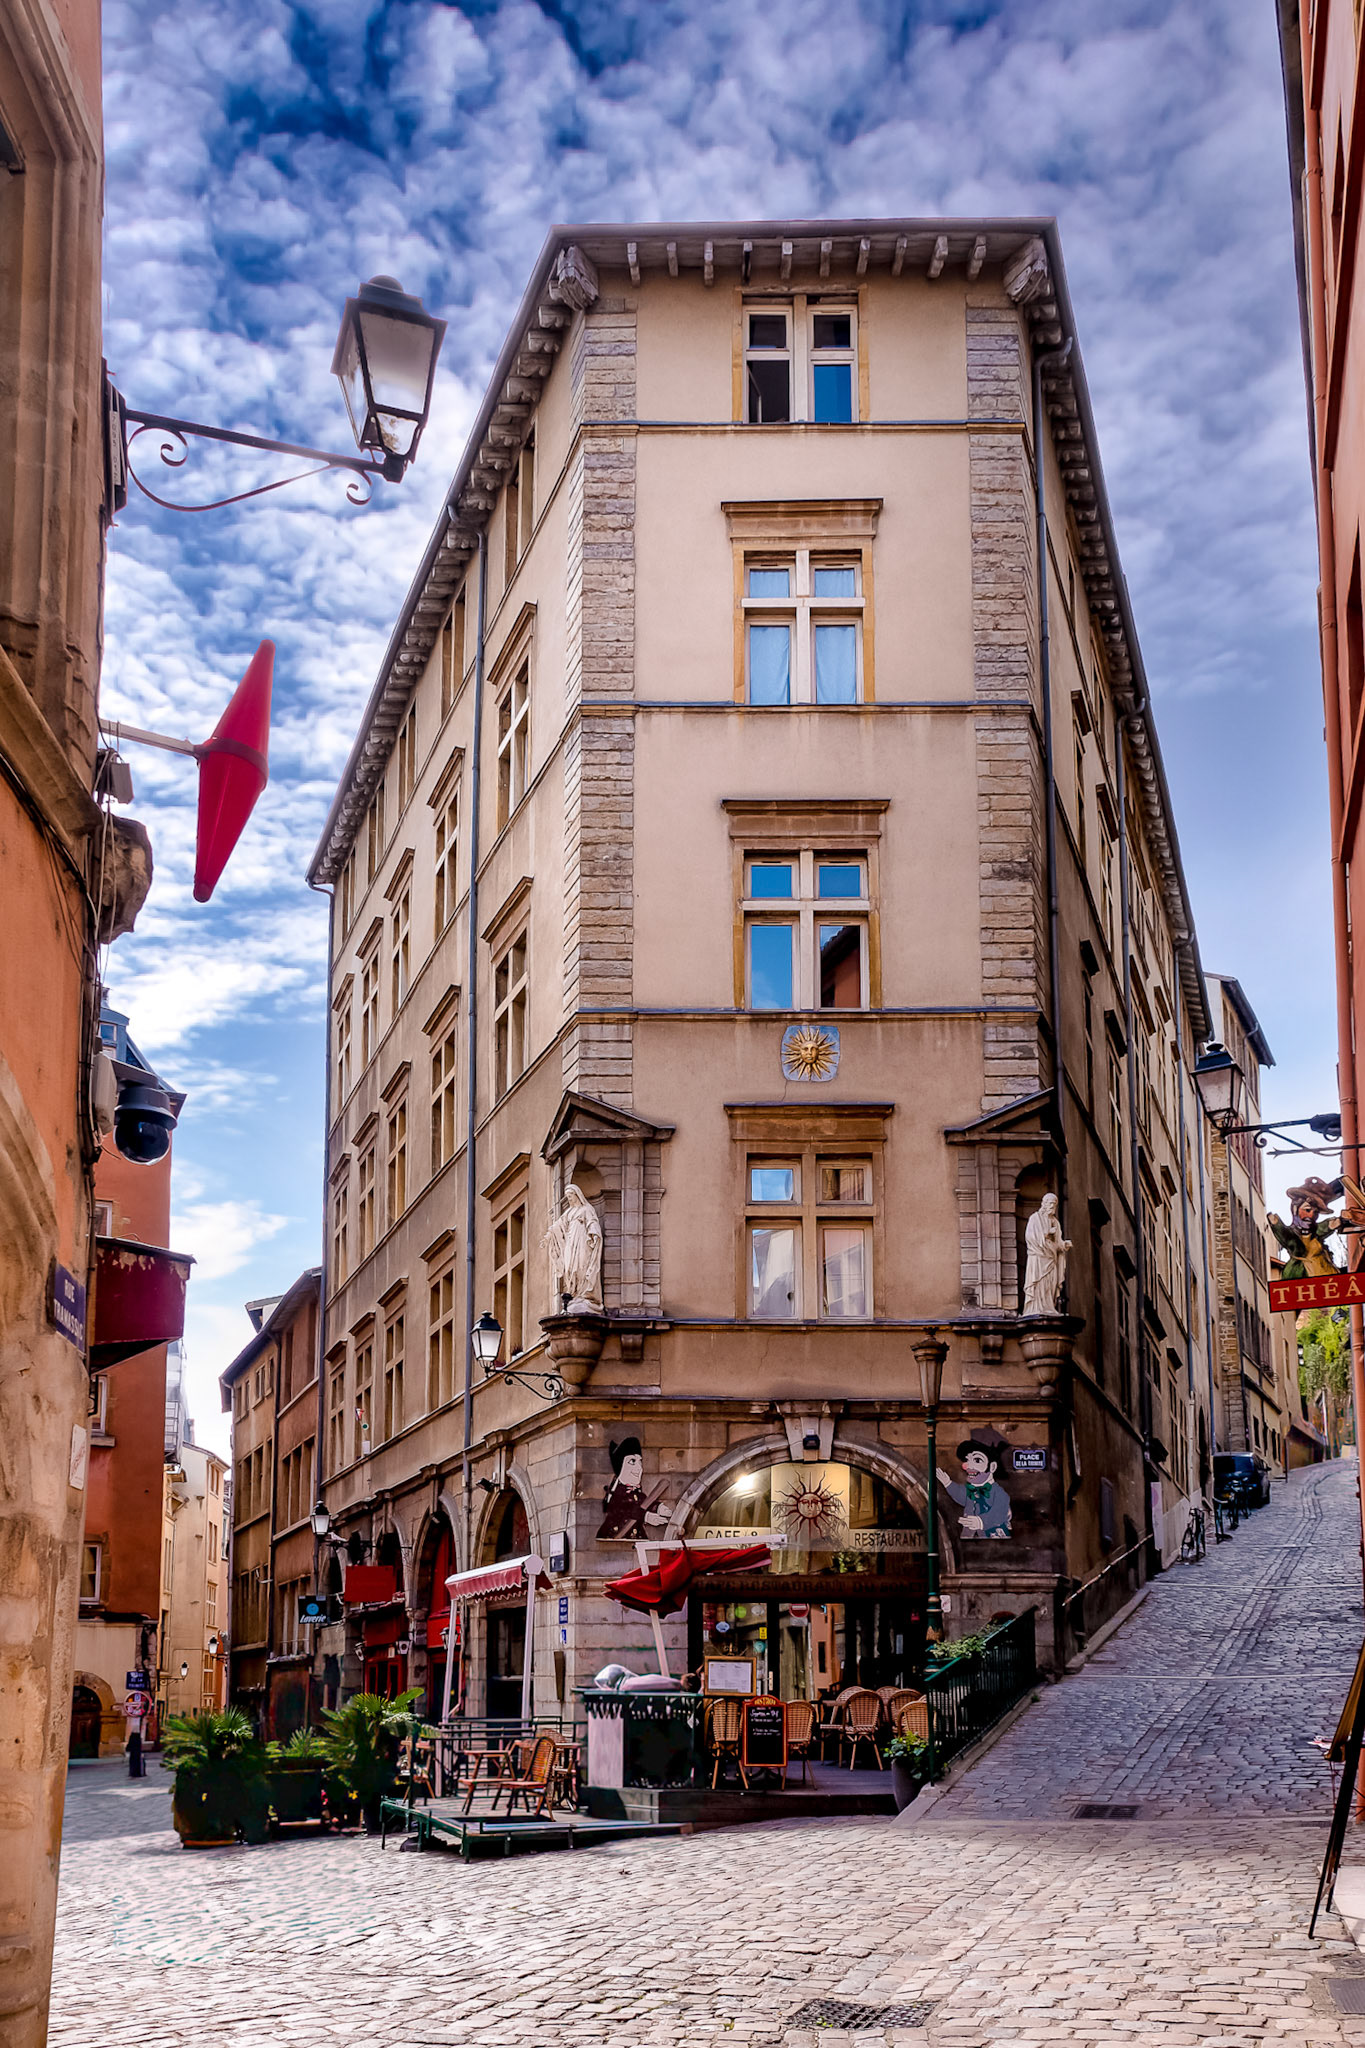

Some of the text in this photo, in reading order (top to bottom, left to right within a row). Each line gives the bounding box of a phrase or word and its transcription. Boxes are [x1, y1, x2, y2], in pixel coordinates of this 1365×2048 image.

[64, 1279, 75, 1303] RUE
[1272, 1275, 1364, 1305] THÉÂ
[854, 1532, 923, 1547] RESTAURANT
[299, 1614, 327, 1623] Laverie
